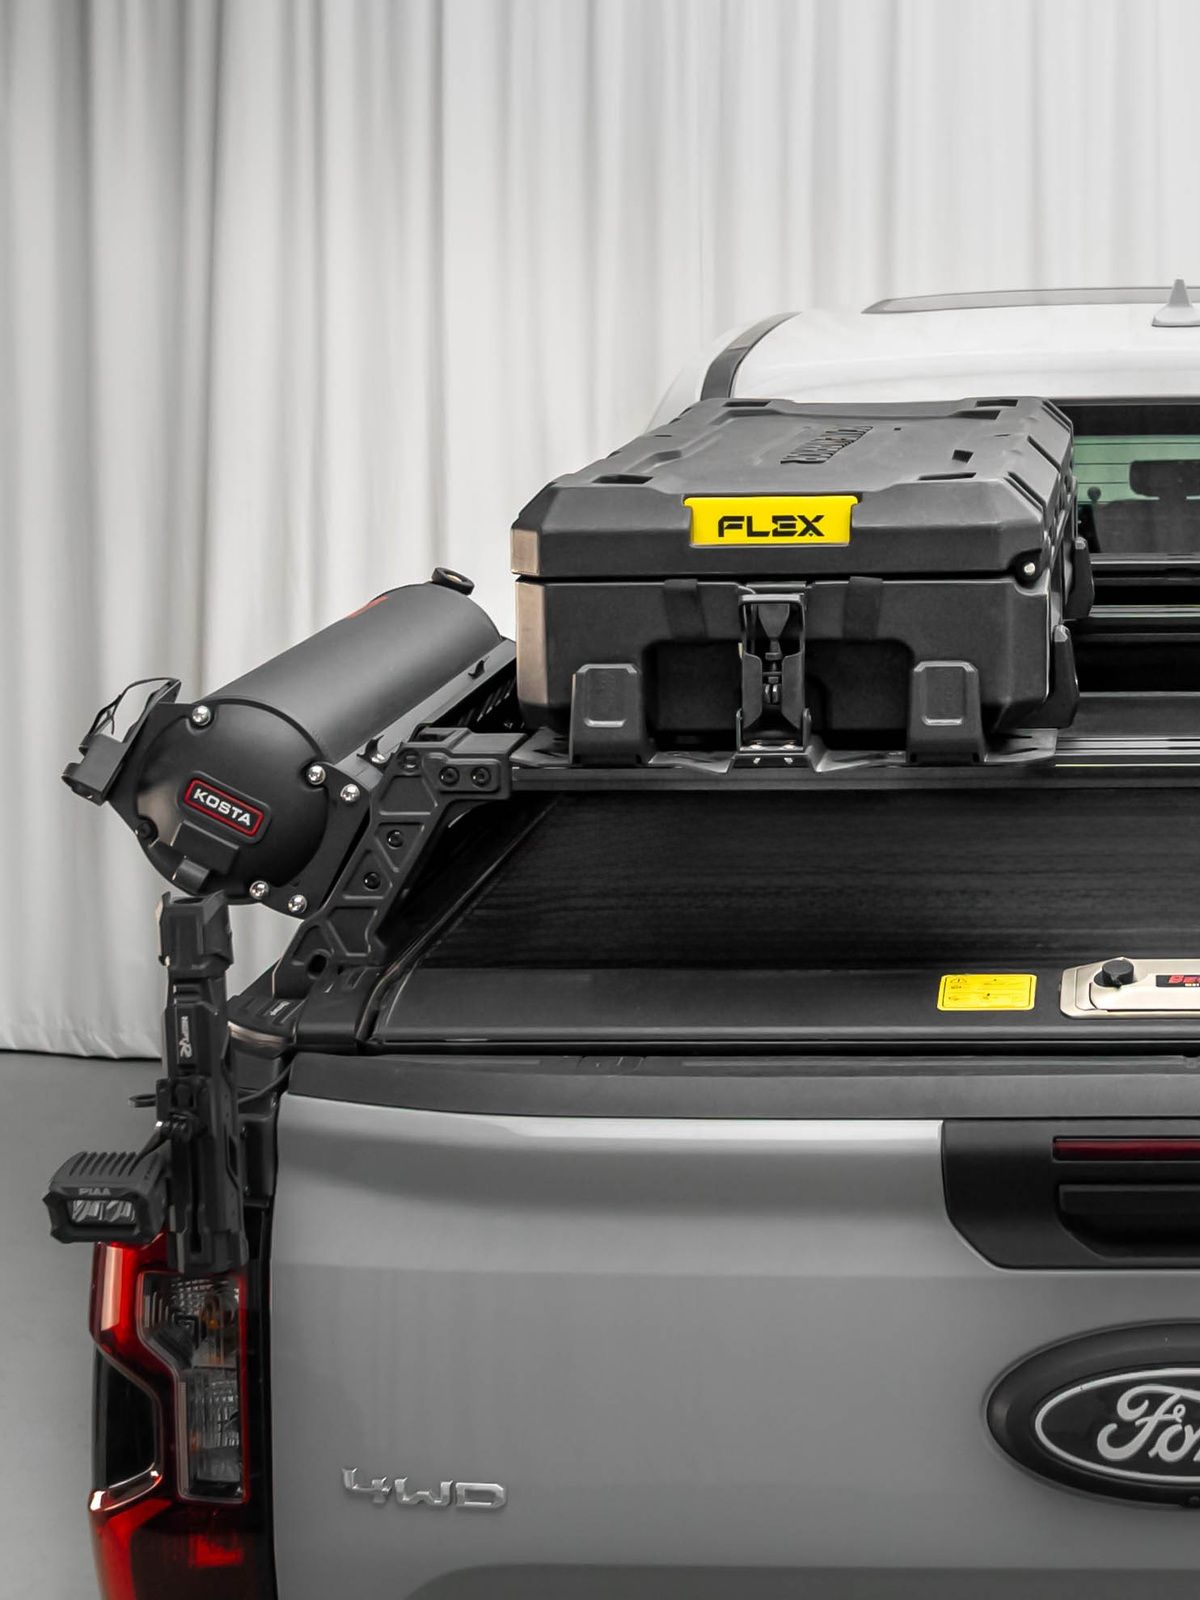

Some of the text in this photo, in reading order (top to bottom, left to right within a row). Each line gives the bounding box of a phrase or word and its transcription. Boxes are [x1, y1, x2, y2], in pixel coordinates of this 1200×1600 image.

[718, 515, 825, 537] FLEX
[193, 788, 251, 826] KOSTA
[342, 1468, 507, 1509] 4WD
